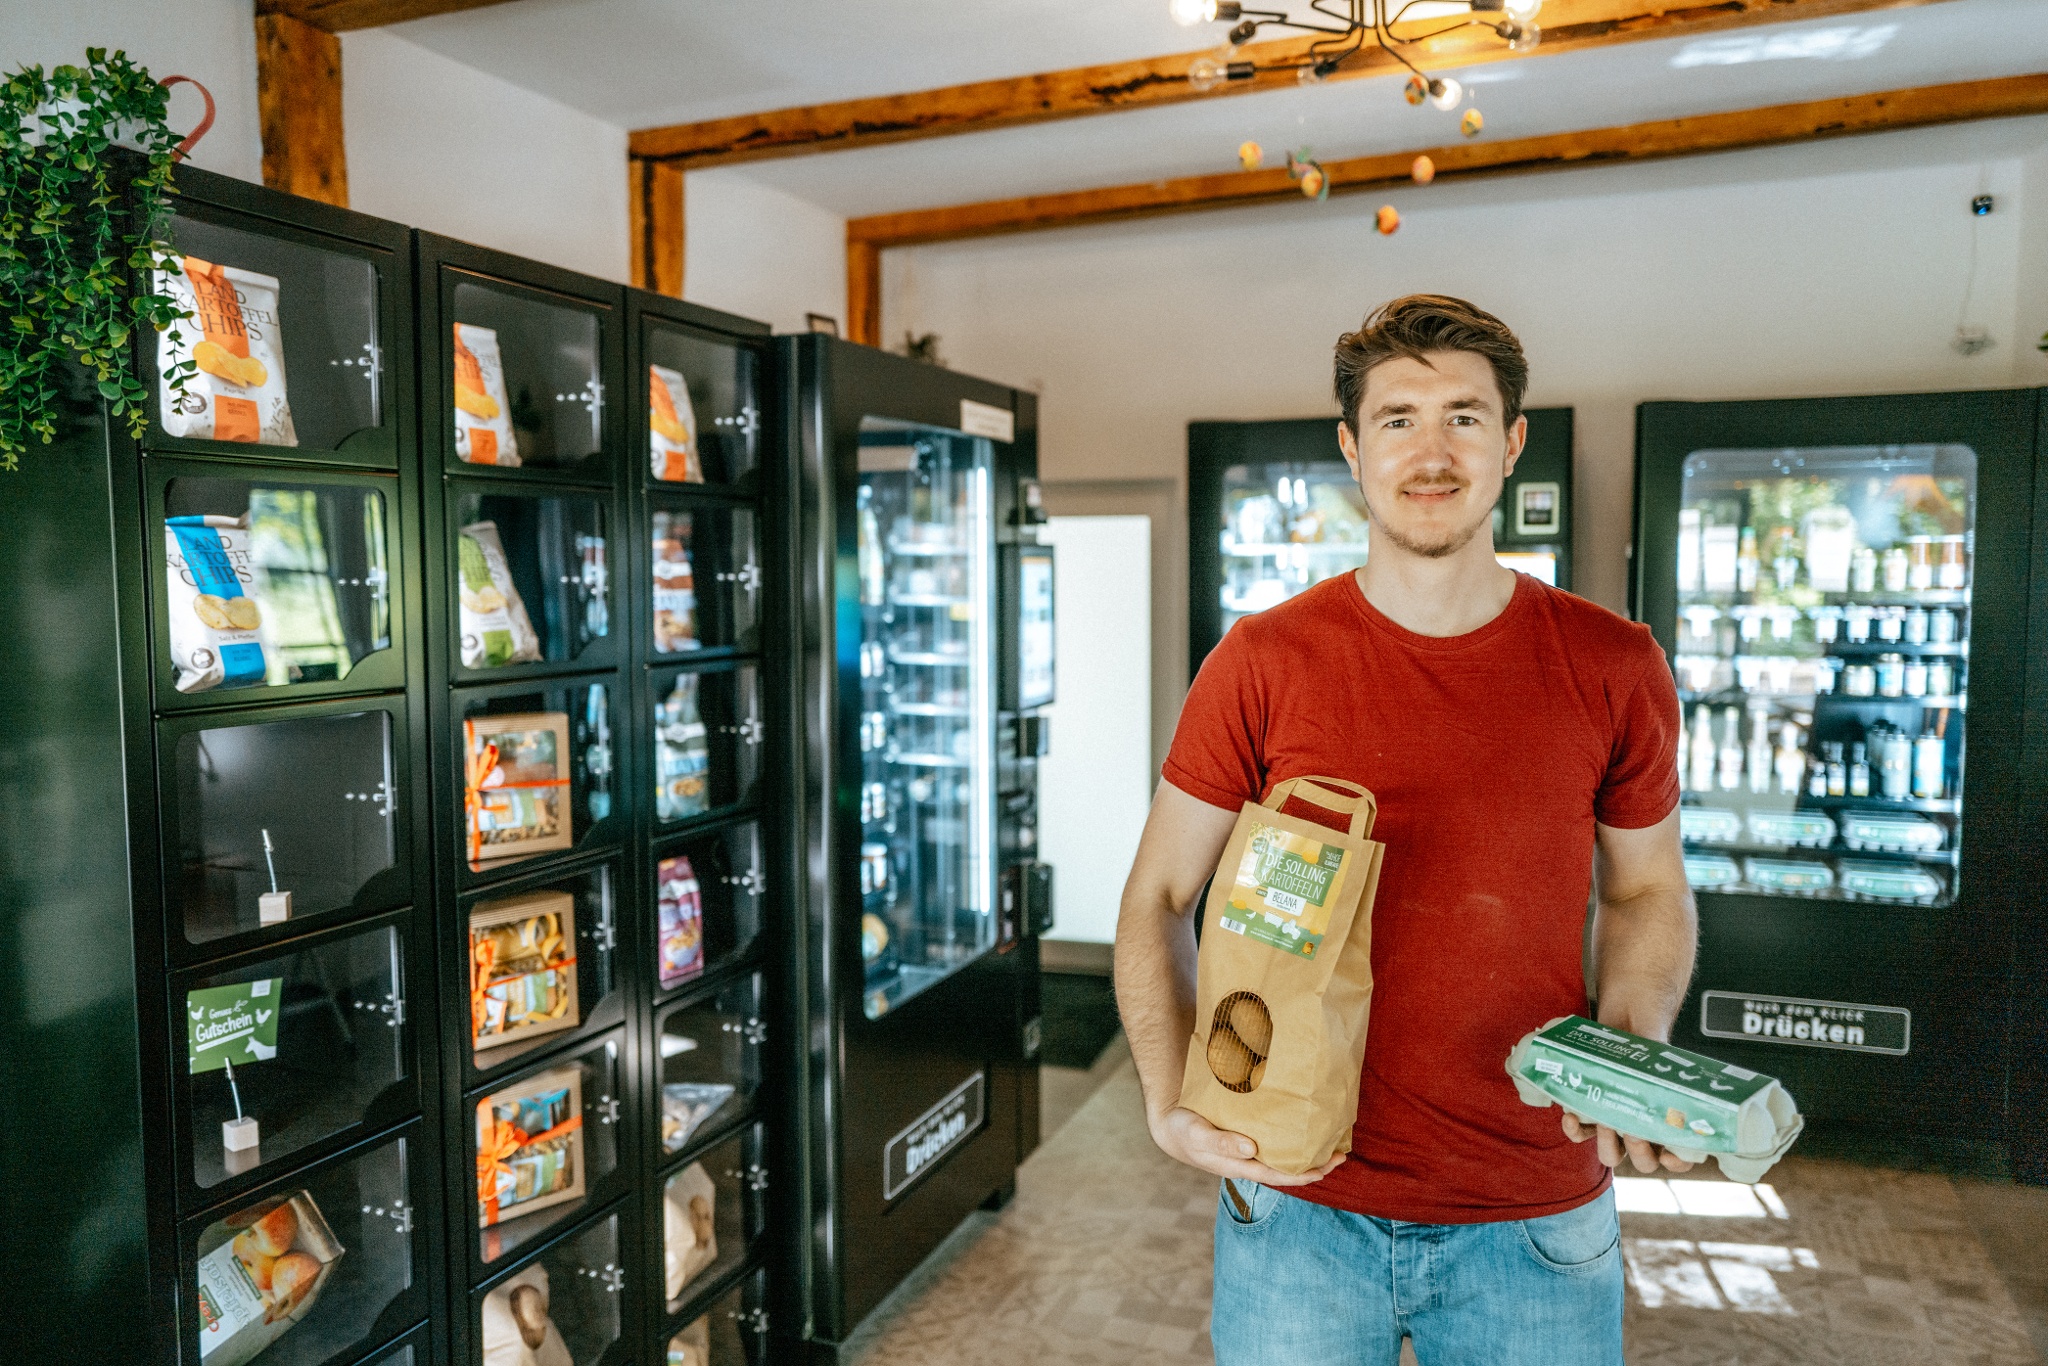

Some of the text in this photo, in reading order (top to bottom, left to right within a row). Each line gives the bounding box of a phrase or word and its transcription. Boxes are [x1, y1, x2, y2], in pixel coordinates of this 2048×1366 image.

[196, 281, 247, 304] LAND
[171, 292, 279, 327] KARTOFFEL
[187, 312, 263, 341] CHIPS
[181, 535, 233, 551] LAND
[167, 549, 254, 568] KARTOFFE
[180, 565, 253, 587] CHIPS
[1265, 853, 1285, 870] DIE
[1284, 859, 1328, 885] SOLLING
[1261, 868, 1323, 900] KARTOFFELN
[1272, 891, 1298, 909] BELANA
[1744, 1001, 1780, 1015] Nach
[1785, 1004, 1815, 1018] dem
[196, 1014, 253, 1043] Gutschein
[1742, 1011, 1865, 1045] Drücken
[1568, 1030, 1588, 1039] DAS
[1591, 1037, 1633, 1054] SOLLING
[1629, 1050, 1651, 1062] Ei
[1586, 1084, 1602, 1102] 10
